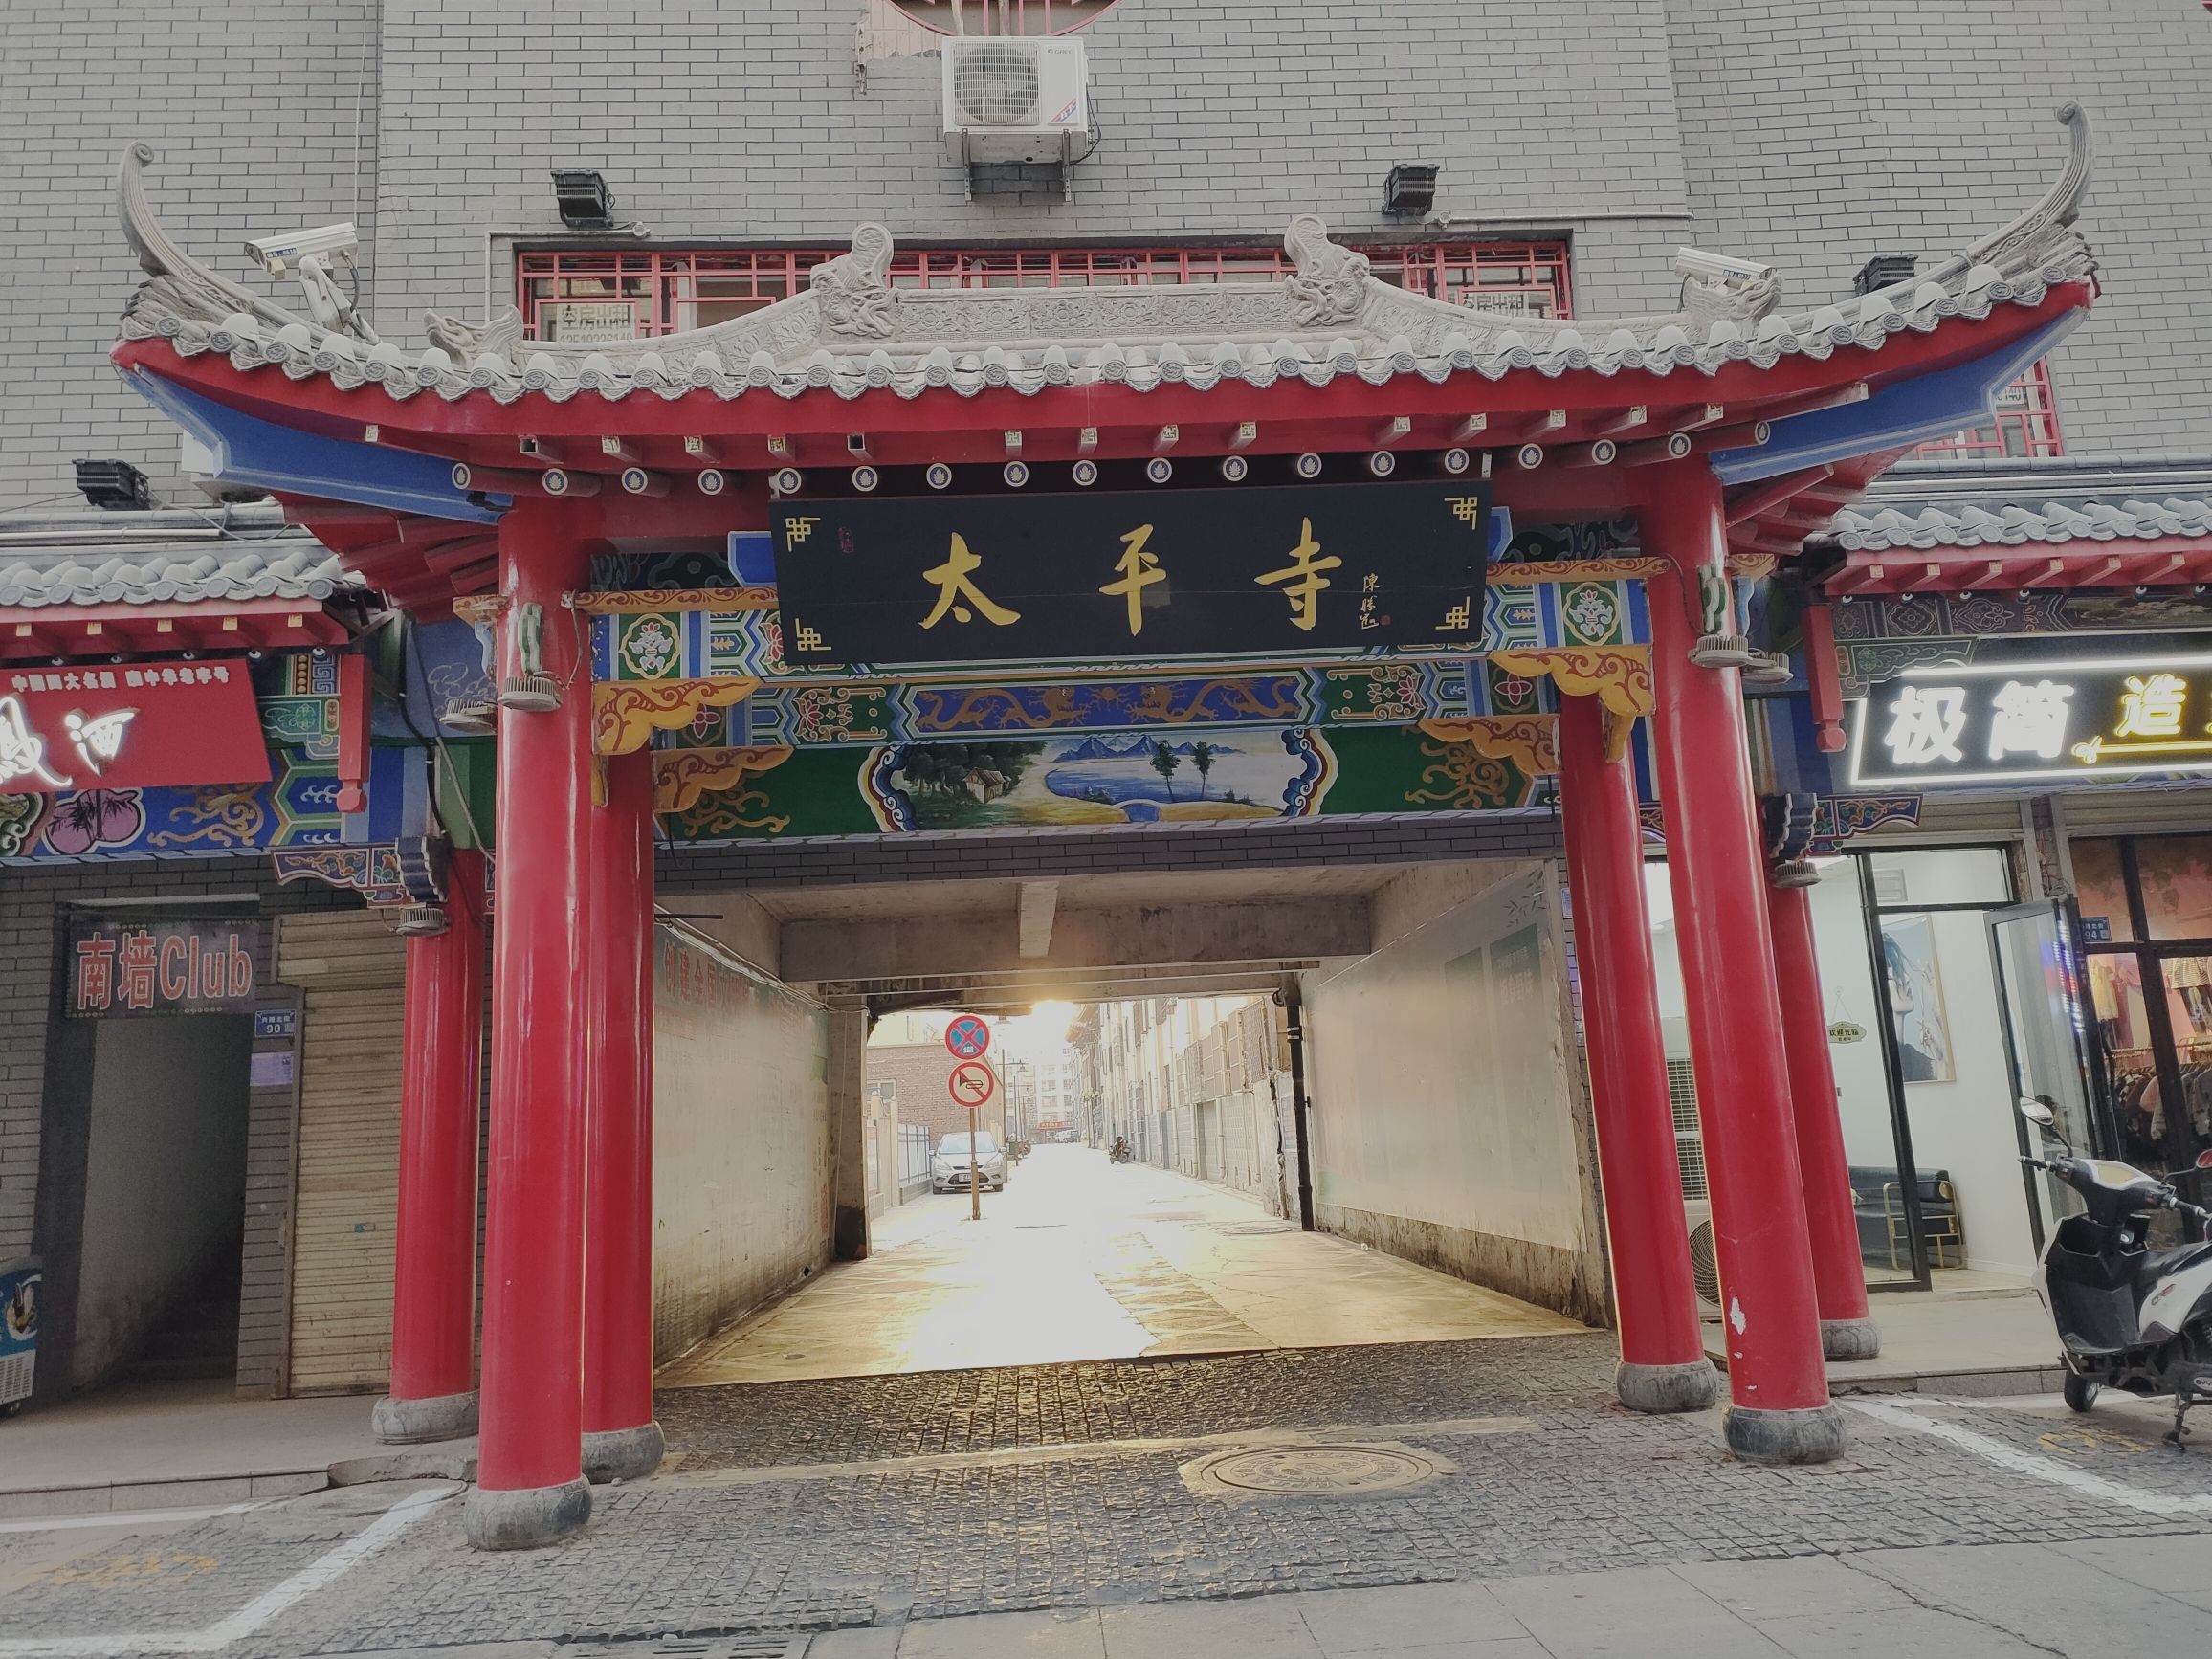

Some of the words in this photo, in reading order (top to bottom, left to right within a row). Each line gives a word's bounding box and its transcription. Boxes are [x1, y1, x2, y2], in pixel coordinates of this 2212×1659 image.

[562, 304, 631, 330] 空房出租
[917, 517, 1342, 637] 太平寺
[77, 929, 253, 1011] 南墙Club
[266, 1023, 281, 1034] 90
